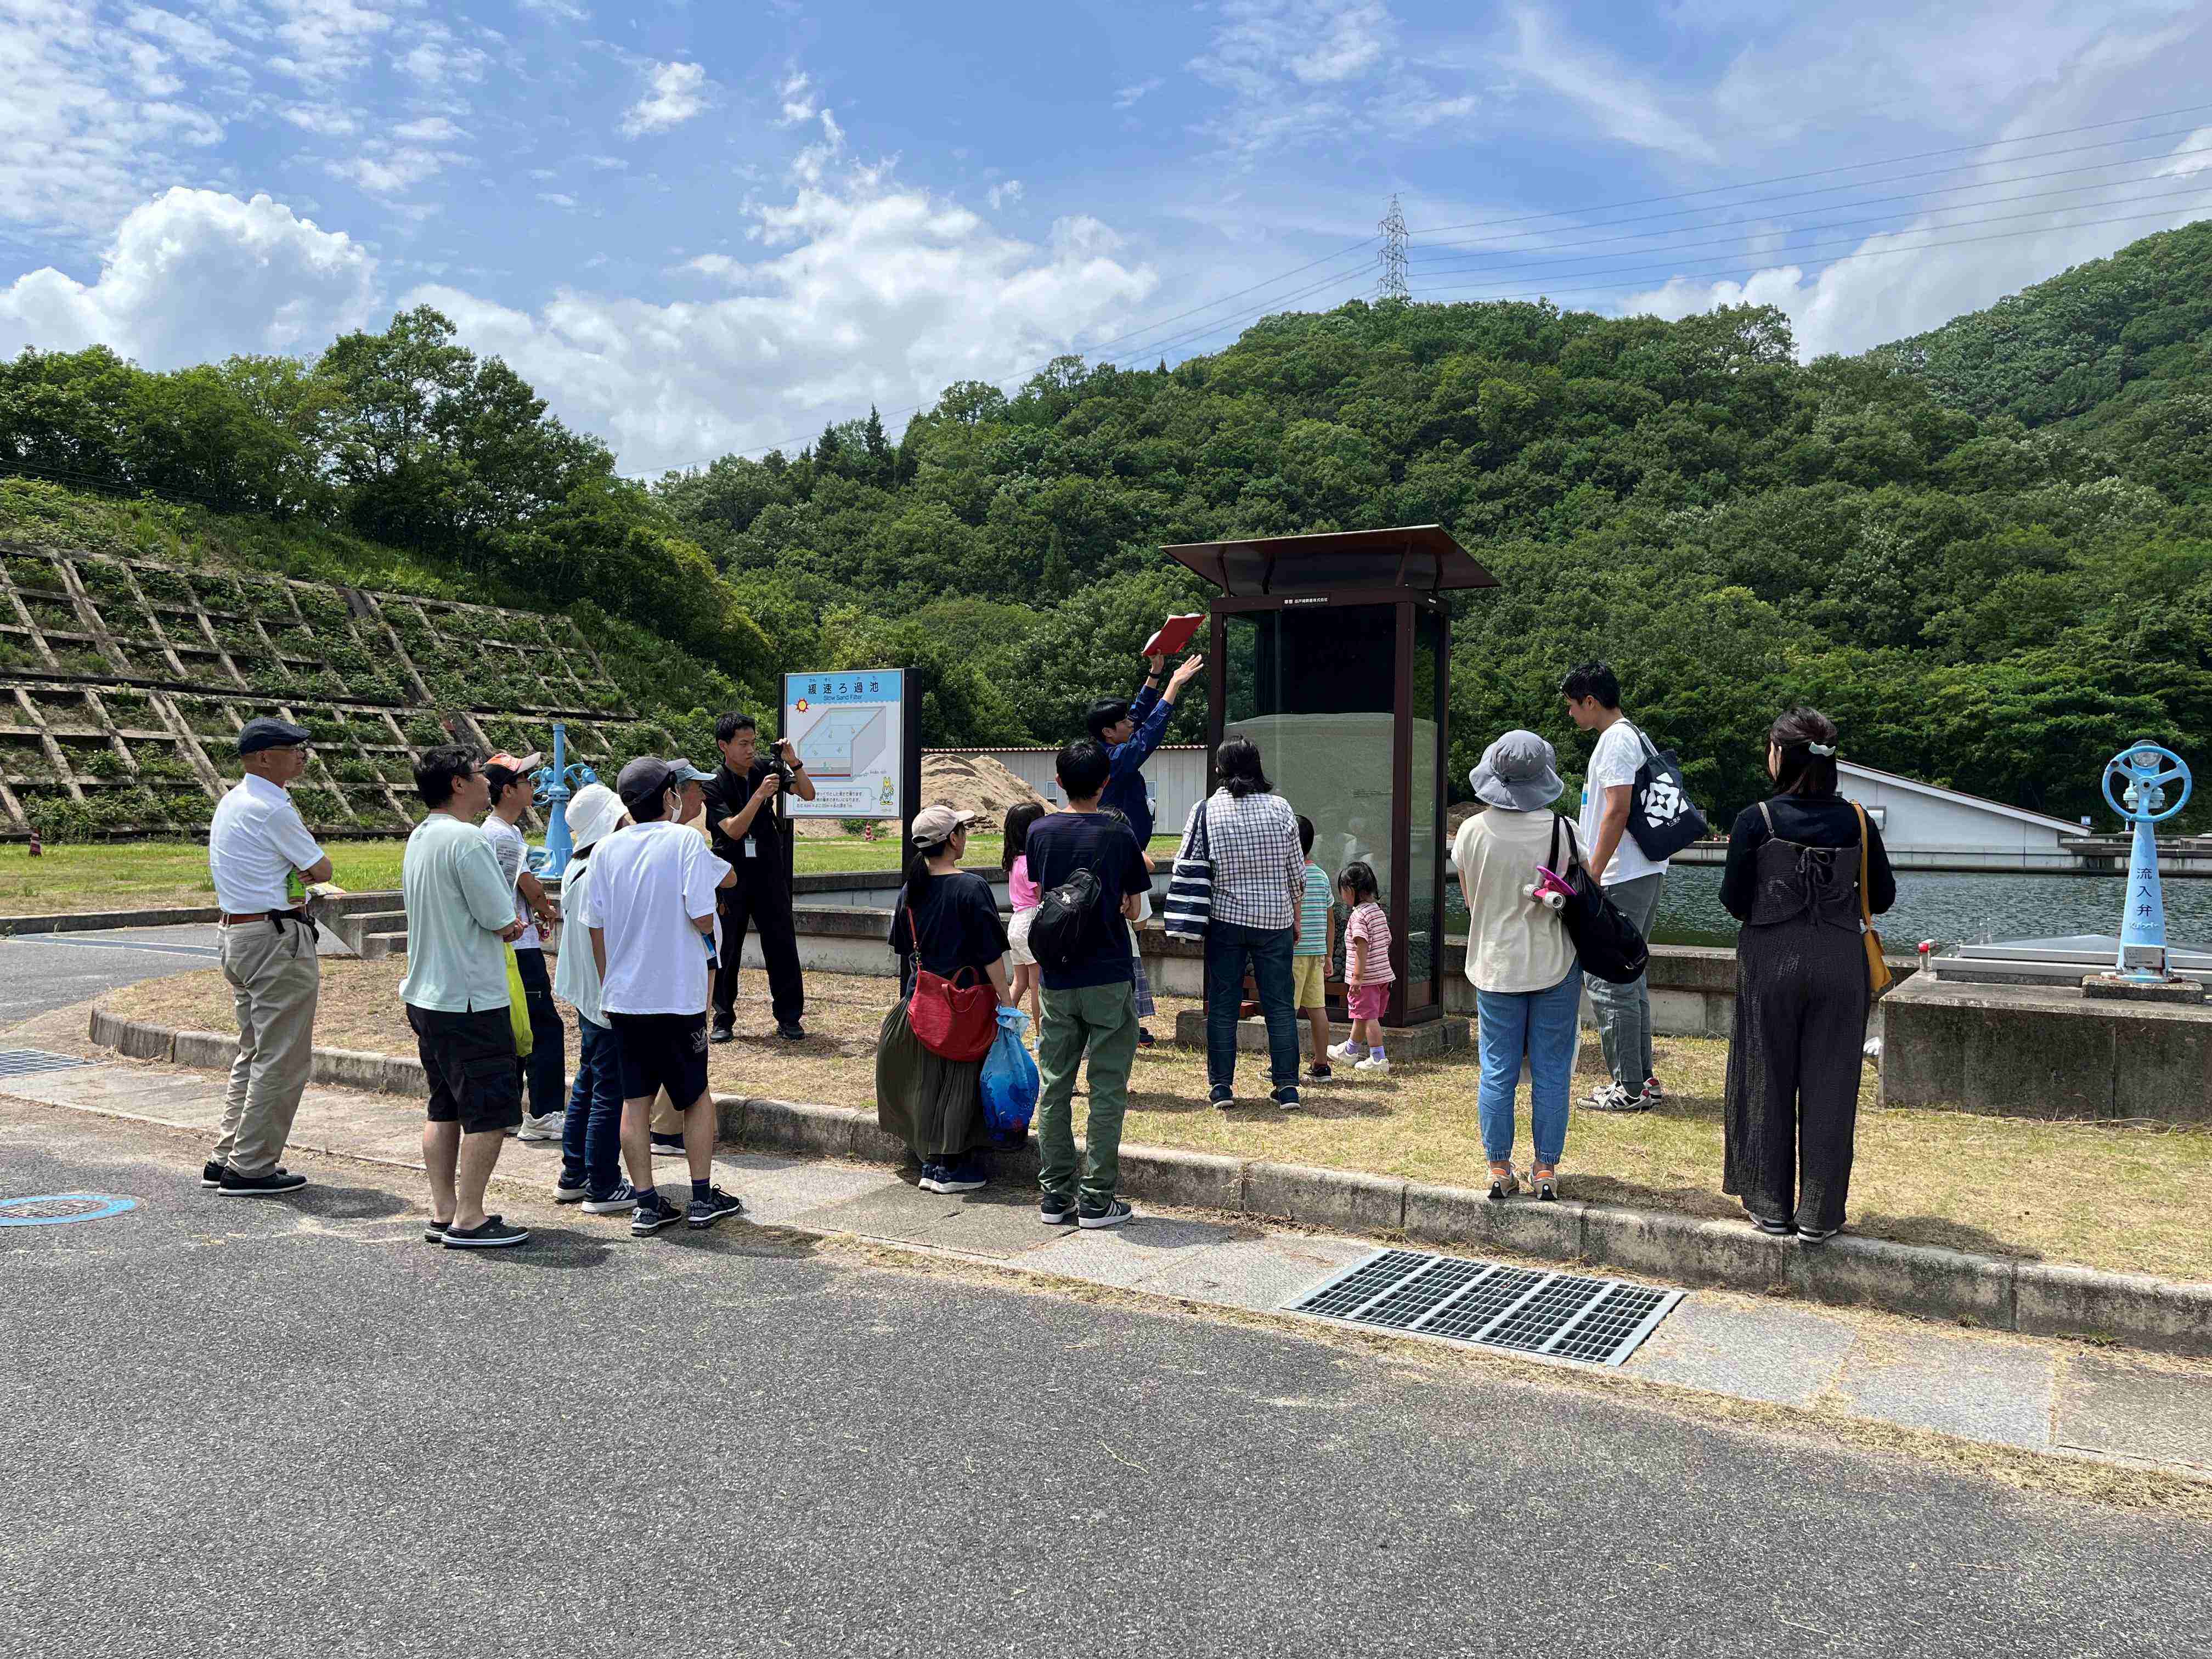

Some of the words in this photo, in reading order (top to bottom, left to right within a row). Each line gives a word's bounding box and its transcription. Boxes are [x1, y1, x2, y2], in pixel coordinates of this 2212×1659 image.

[808, 682, 879, 695] 緩速ろ過池
[2136, 868, 2153, 917] 流入弁
